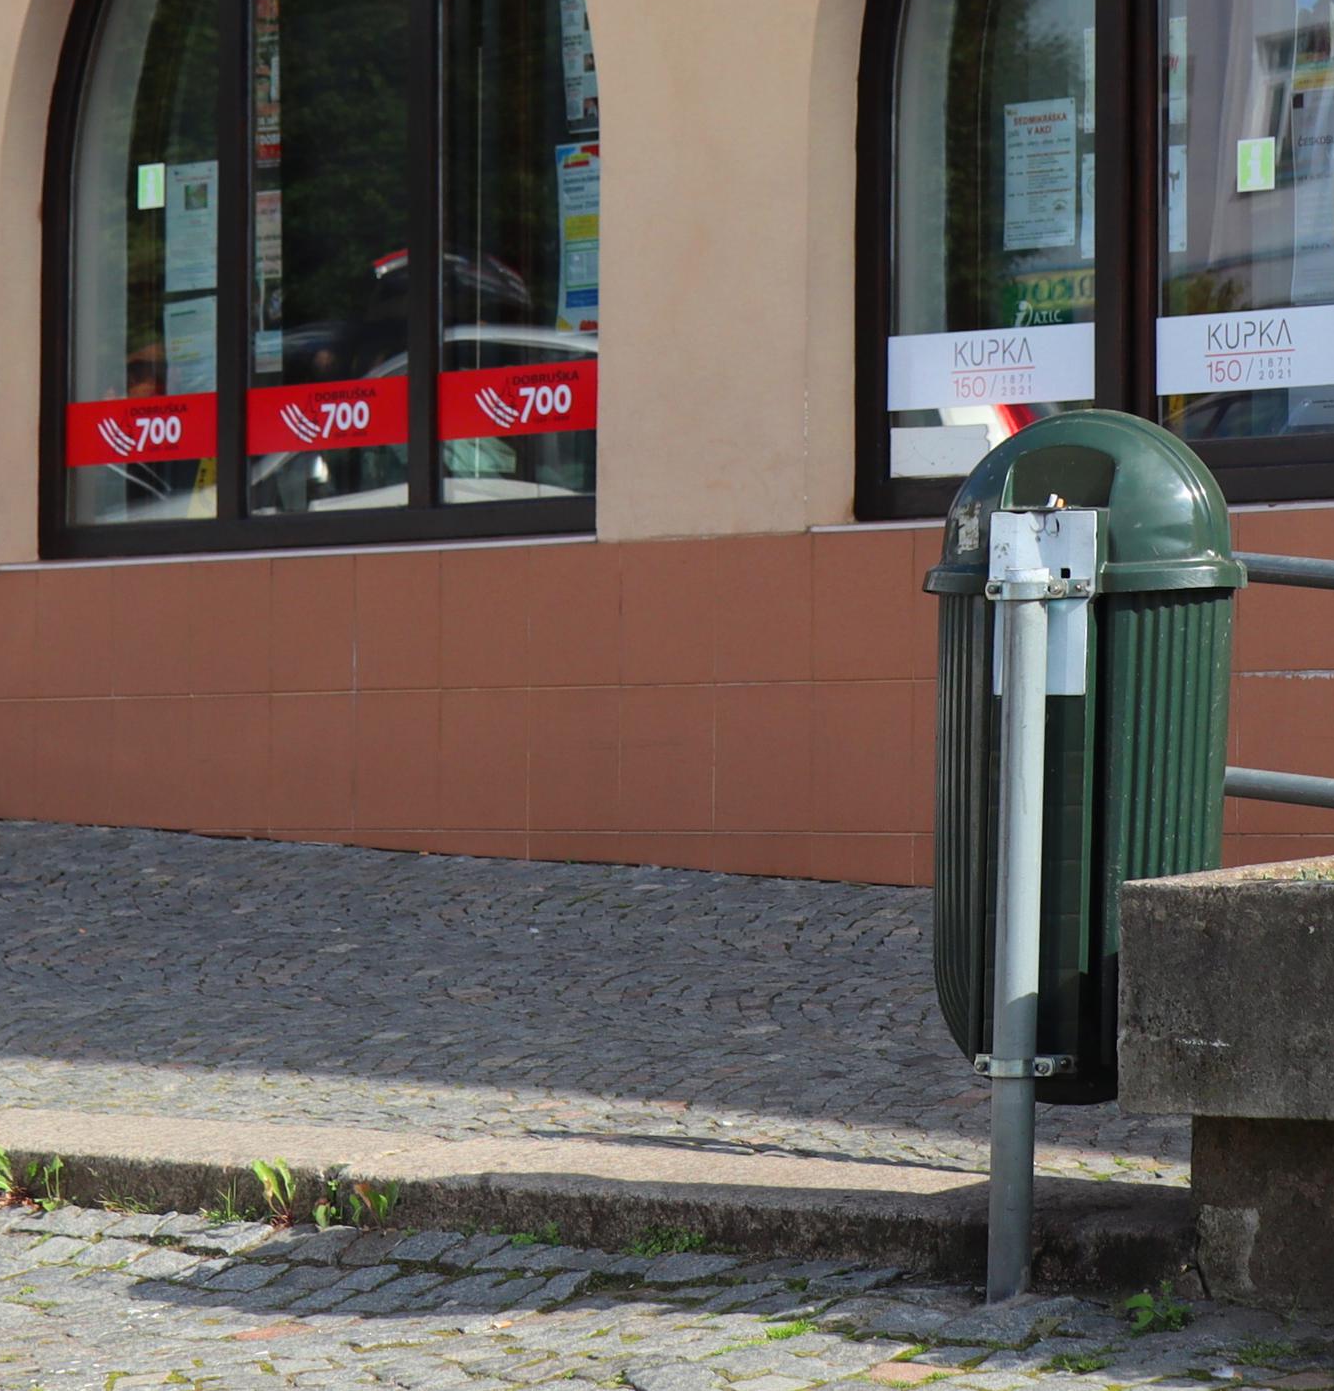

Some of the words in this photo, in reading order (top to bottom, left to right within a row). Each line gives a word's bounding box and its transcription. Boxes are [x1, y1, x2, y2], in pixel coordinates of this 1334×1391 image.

[1207, 318, 1292, 350] KUPKA
[954, 336, 1033, 368] KUPKA
[1258, 356, 1292, 369] 1871
[512, 369, 580, 386] DOBRUŠKA
[1001, 374, 1033, 385] 1871
[1258, 368, 1292, 381] 2021
[314, 386, 377, 403] DOBRUŠKA
[1001, 385, 1033, 397] 2021
[130, 403, 187, 417] DOBRUŠKA
[518, 384, 572, 424] 700
[320, 401, 370, 439] 700
[135, 416, 182, 453] 700
